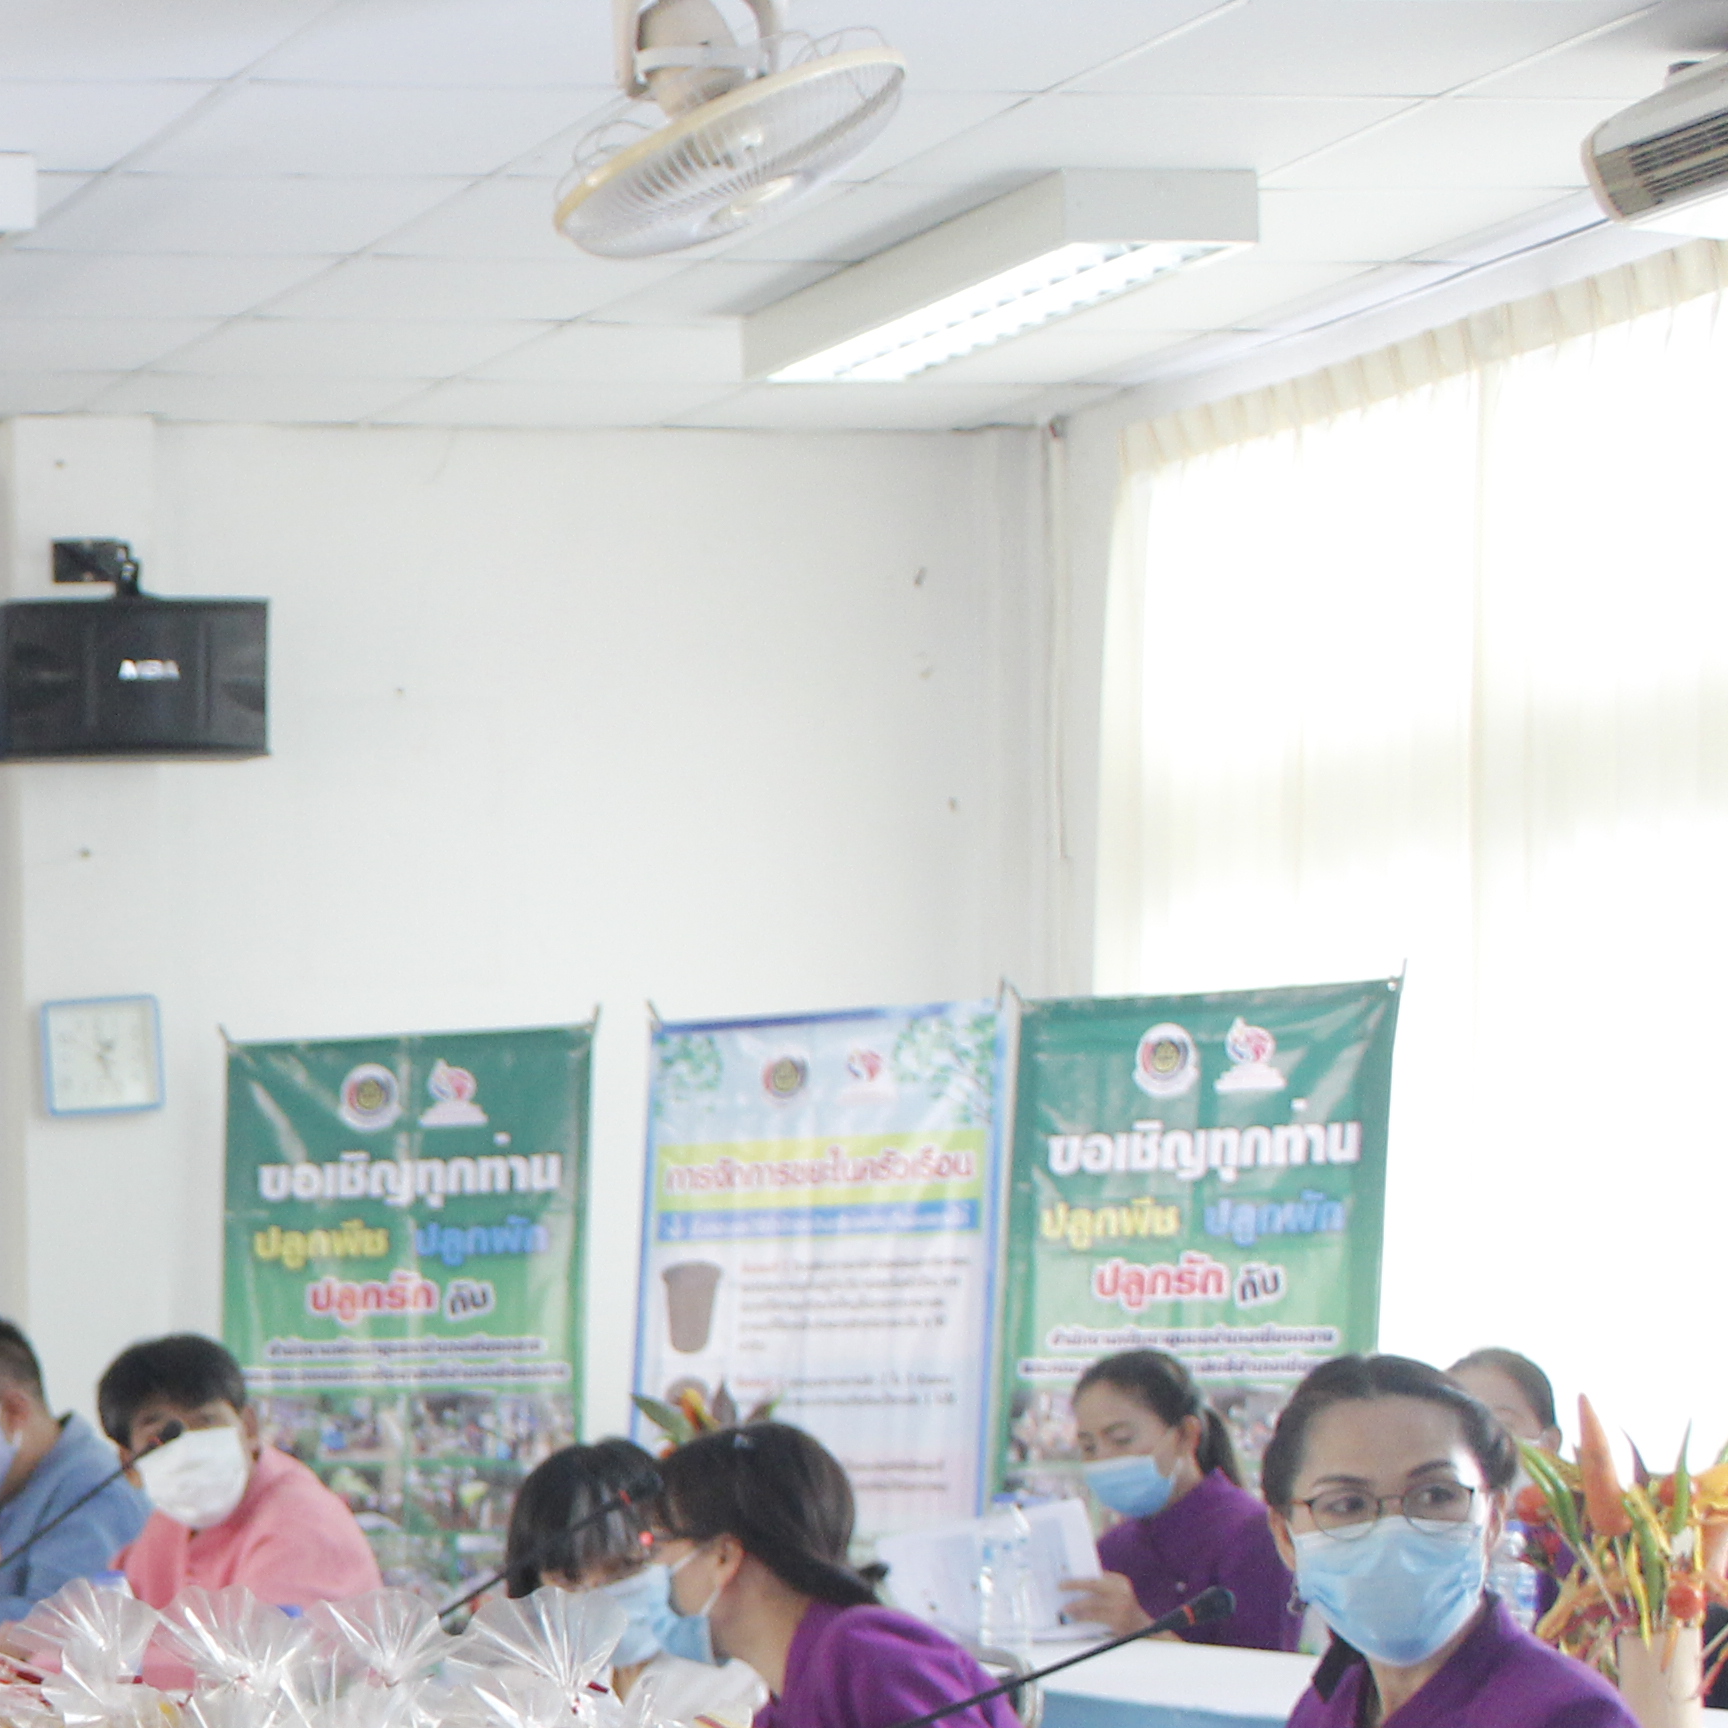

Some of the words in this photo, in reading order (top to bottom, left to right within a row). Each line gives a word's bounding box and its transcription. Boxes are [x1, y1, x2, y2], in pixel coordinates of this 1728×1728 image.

[258, 1131, 563, 1208] ขอเชิญทุกท่าน
[1047, 1097, 1362, 1182] ขอเชิญทุกท่าน
[309, 1271, 437, 1323] ปลูกรัก
[1097, 1252, 1227, 1310] ปลูกรัก
